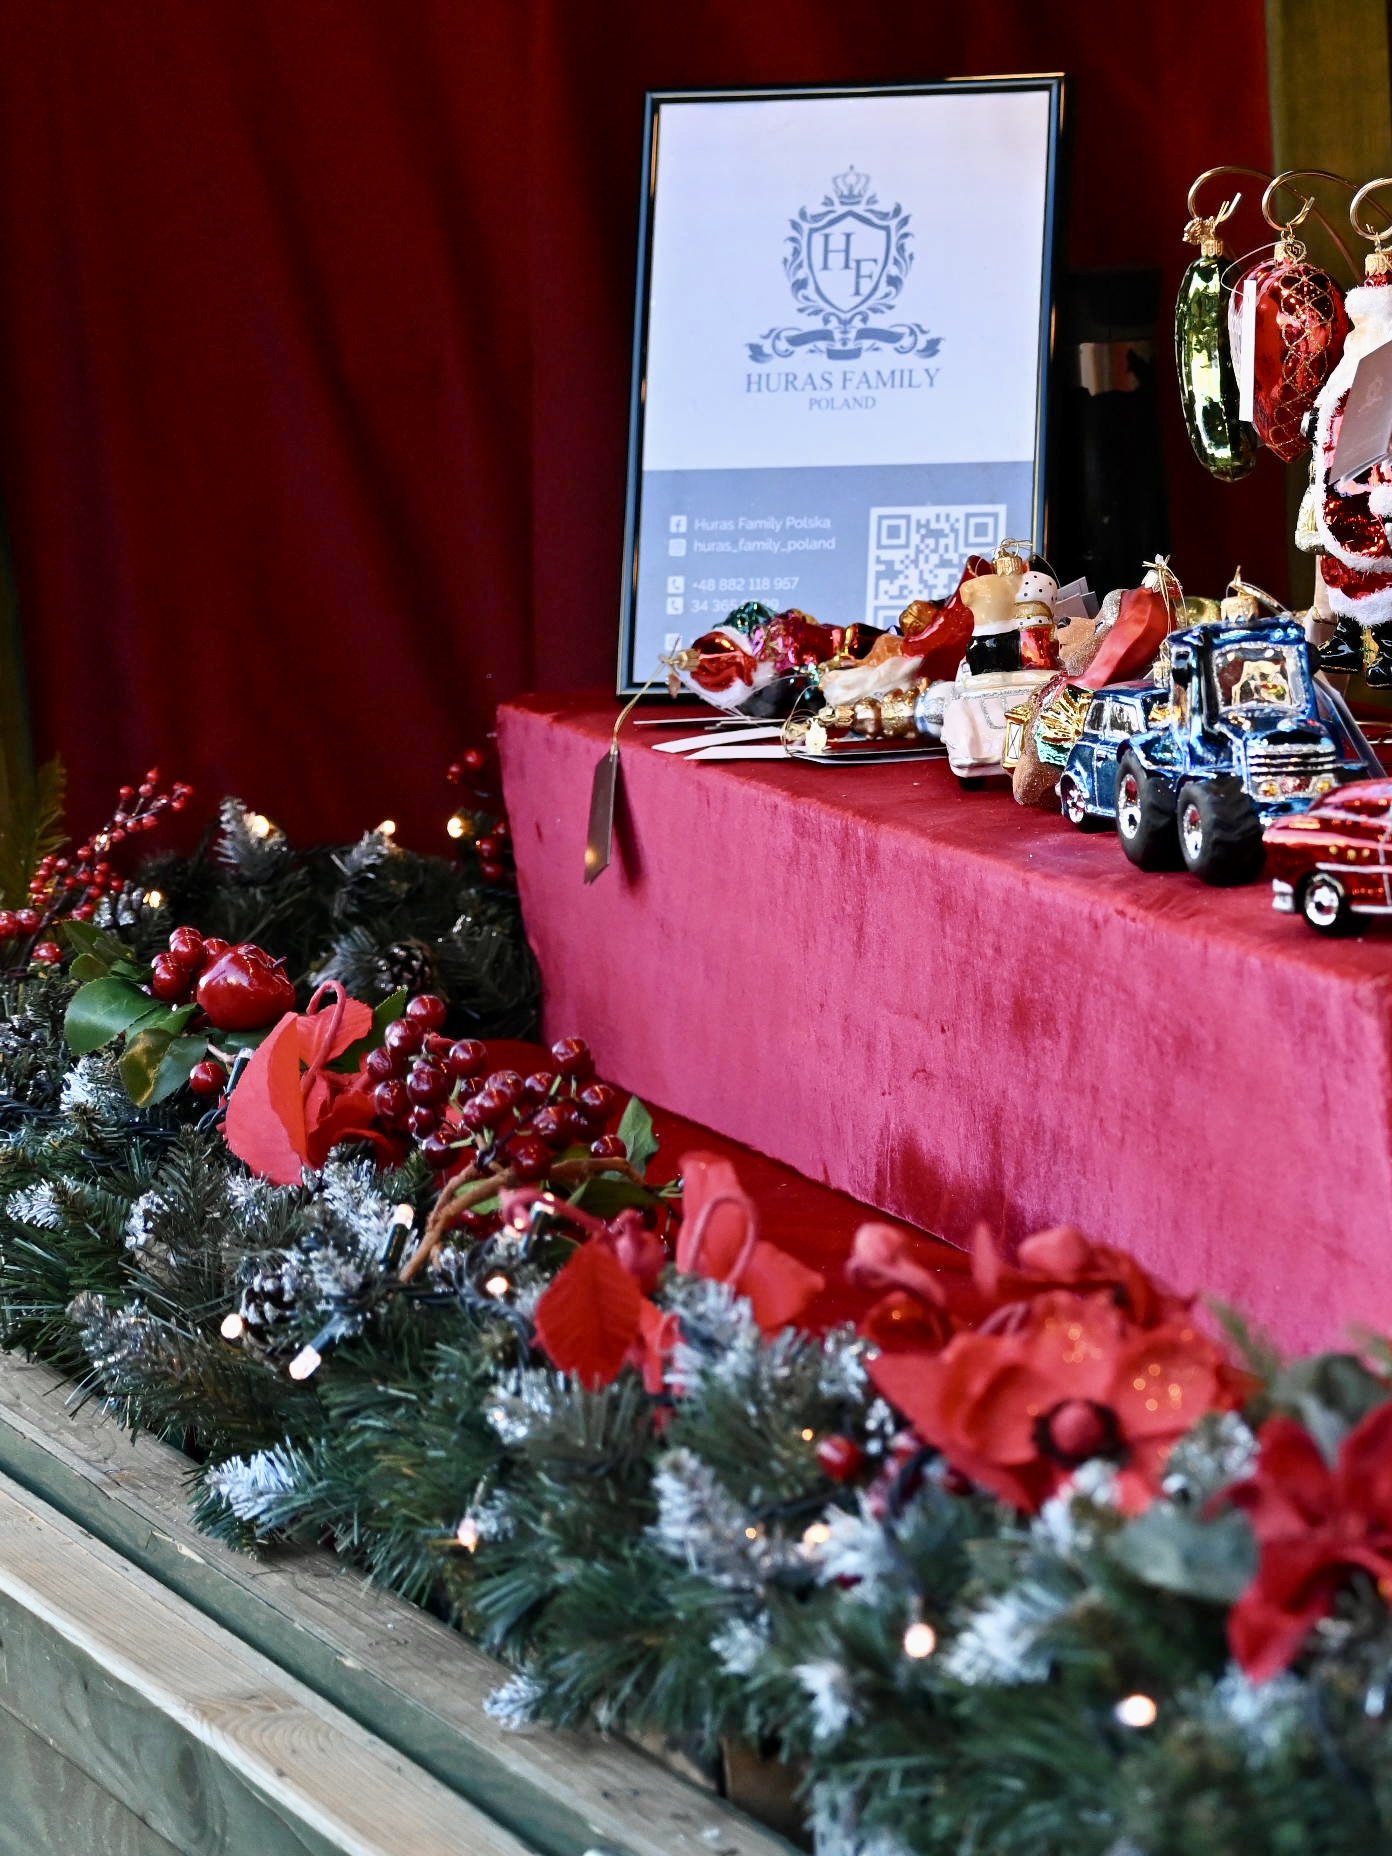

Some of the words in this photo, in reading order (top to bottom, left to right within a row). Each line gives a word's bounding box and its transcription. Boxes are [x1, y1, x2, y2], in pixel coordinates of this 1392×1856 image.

[746, 371, 833, 393] HURAS
[842, 368, 941, 390] FAMILY
[808, 396, 877, 411] POLAND
[694, 518, 734, 531] Huras
[738, 515, 782, 533] Family
[785, 516, 831, 530] Polska
[719, 577, 745, 591] 882
[749, 577, 770, 590] 118
[773, 576, 800, 590] 957
[690, 599, 708, 613] 34
